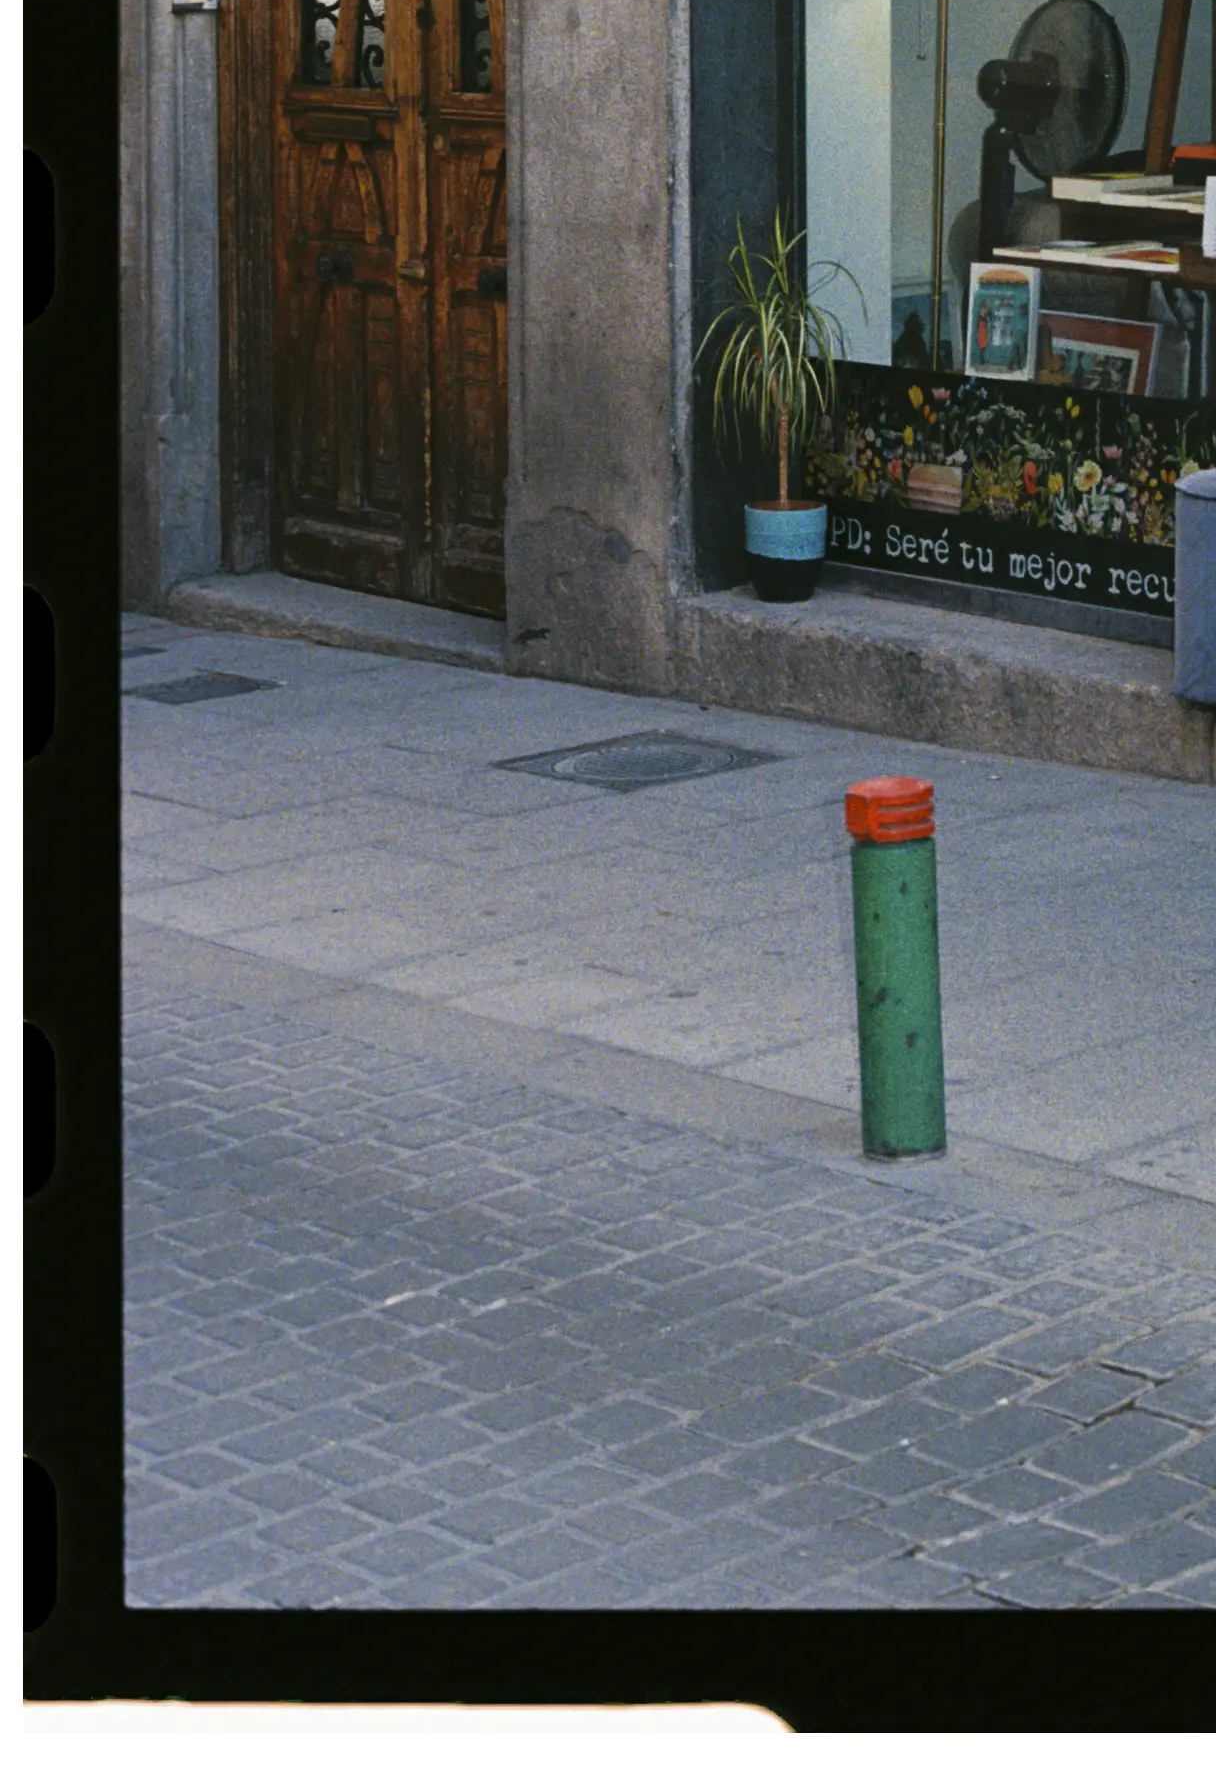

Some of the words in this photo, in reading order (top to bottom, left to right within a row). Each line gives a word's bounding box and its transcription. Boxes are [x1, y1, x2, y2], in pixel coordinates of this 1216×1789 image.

[830, 515, 872, 555] PD:
[885, 524, 949, 564] Seré
[959, 540, 994, 573] tu
[1009, 551, 1092, 591] mejor
